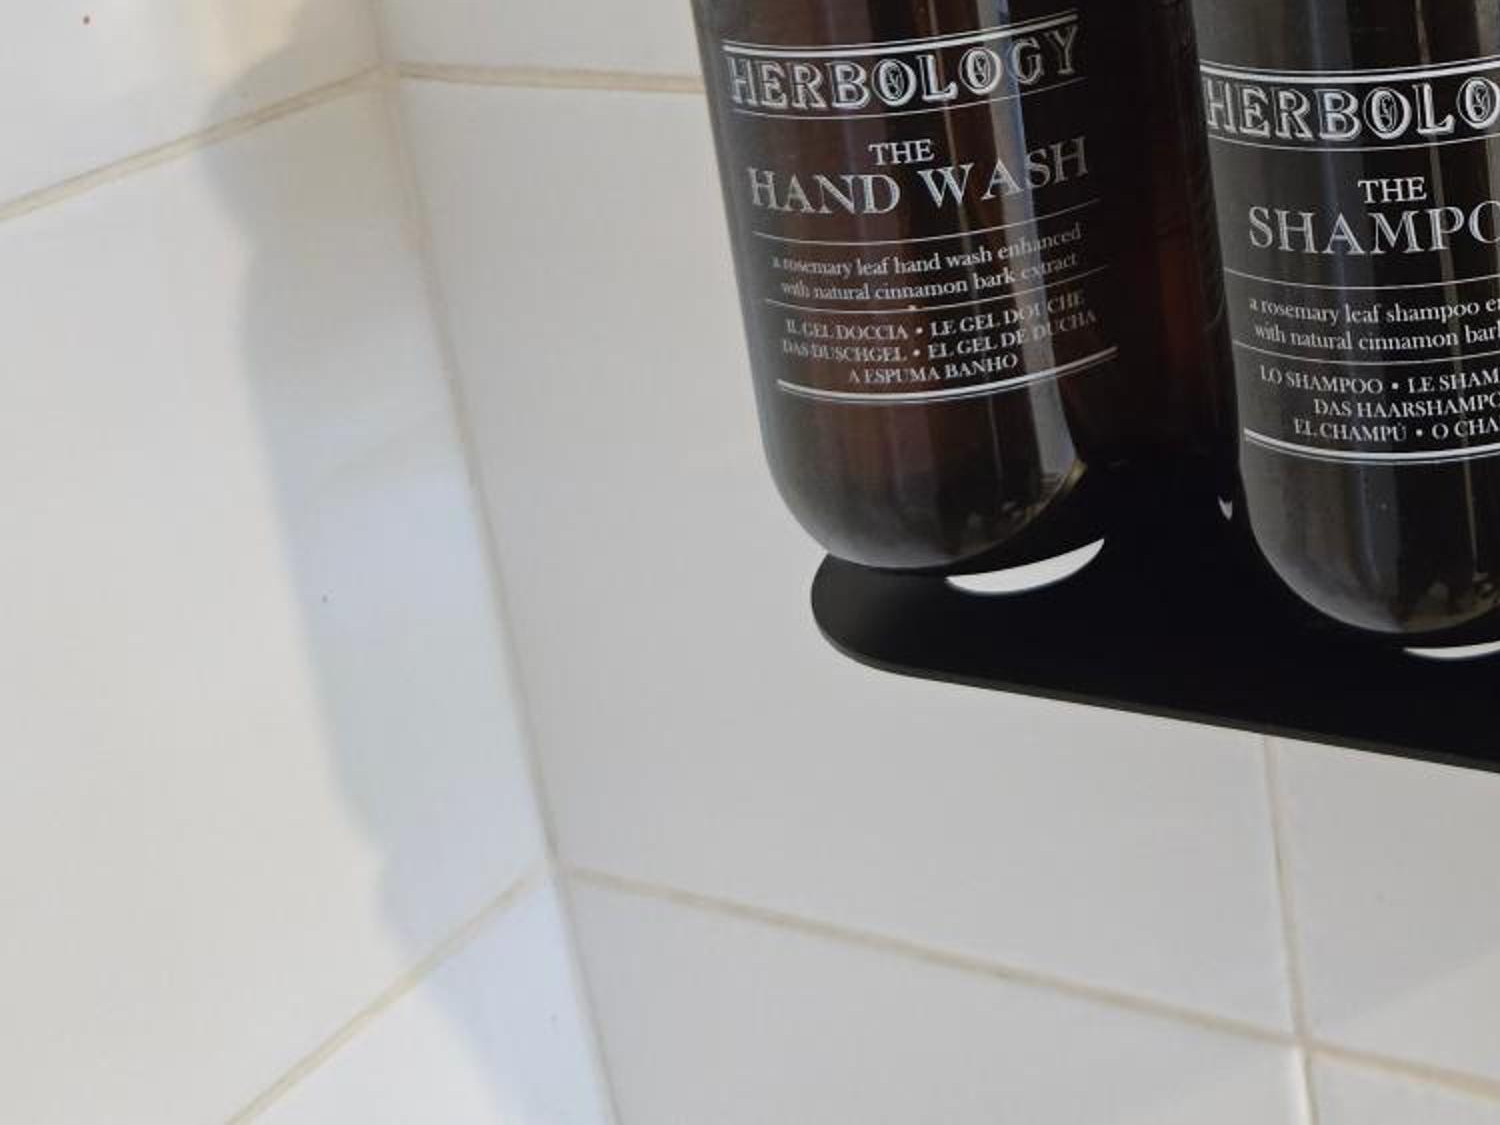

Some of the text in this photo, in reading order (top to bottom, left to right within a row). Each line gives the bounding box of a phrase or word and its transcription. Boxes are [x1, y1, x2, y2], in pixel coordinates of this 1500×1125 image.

[726, 24, 1079, 110] HERBOLOGY
[868, 139, 935, 167] THE
[747, 136, 1090, 214] HAND WASH
[1357, 176, 1427, 204] THE
[856, 257, 891, 275] leaf
[894, 252, 941, 273] hand
[945, 246, 992, 267] wash
[997, 221, 1082, 258] enhanced
[814, 284, 871, 300] natural
[875, 279, 968, 299] cinnamon
[973, 267, 1015, 290] bark
[836, 324, 909, 340] DOCCIA
[930, 320, 957, 337] LE
[959, 312, 1000, 332] GEL
[1261, 299, 1339, 326] rosemary
[1345, 303, 1382, 324] leaf
[1386, 300, 1480, 324] shampoo
[928, 343, 954, 359] EL
[957, 336, 997, 354] GEL
[1000, 329, 1027, 347] DE
[1254, 321, 1286, 344] with
[1291, 331, 1353, 350] natural
[1359, 331, 1459, 350] cinnamon
[850, 353, 1018, 384] A ESPUMA BANHO
[1260, 365, 1282, 385] LO
[1285, 372, 1383, 394] SHAMPOO
[1408, 376, 1435, 394] LE
[1313, 398, 1352, 416] DAS
[1294, 418, 1316, 436] EL
[1432, 423, 1449, 440] O
